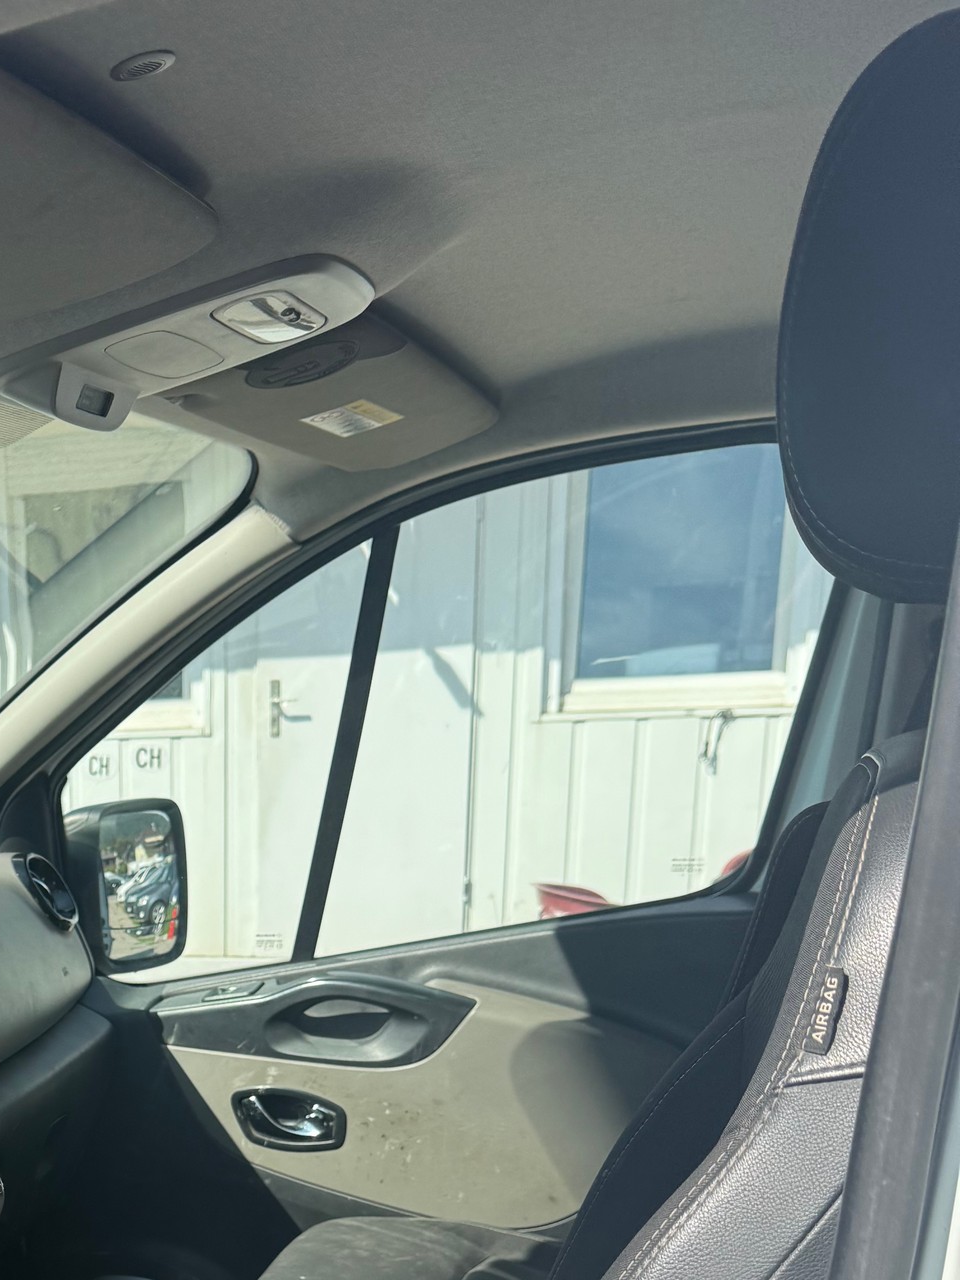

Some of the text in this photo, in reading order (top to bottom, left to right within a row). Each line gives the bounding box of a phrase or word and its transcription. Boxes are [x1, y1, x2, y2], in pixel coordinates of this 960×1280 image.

[88, 755, 111, 777] CH
[135, 747, 162, 769] CH
[811, 977, 839, 1044] AIRBAG
